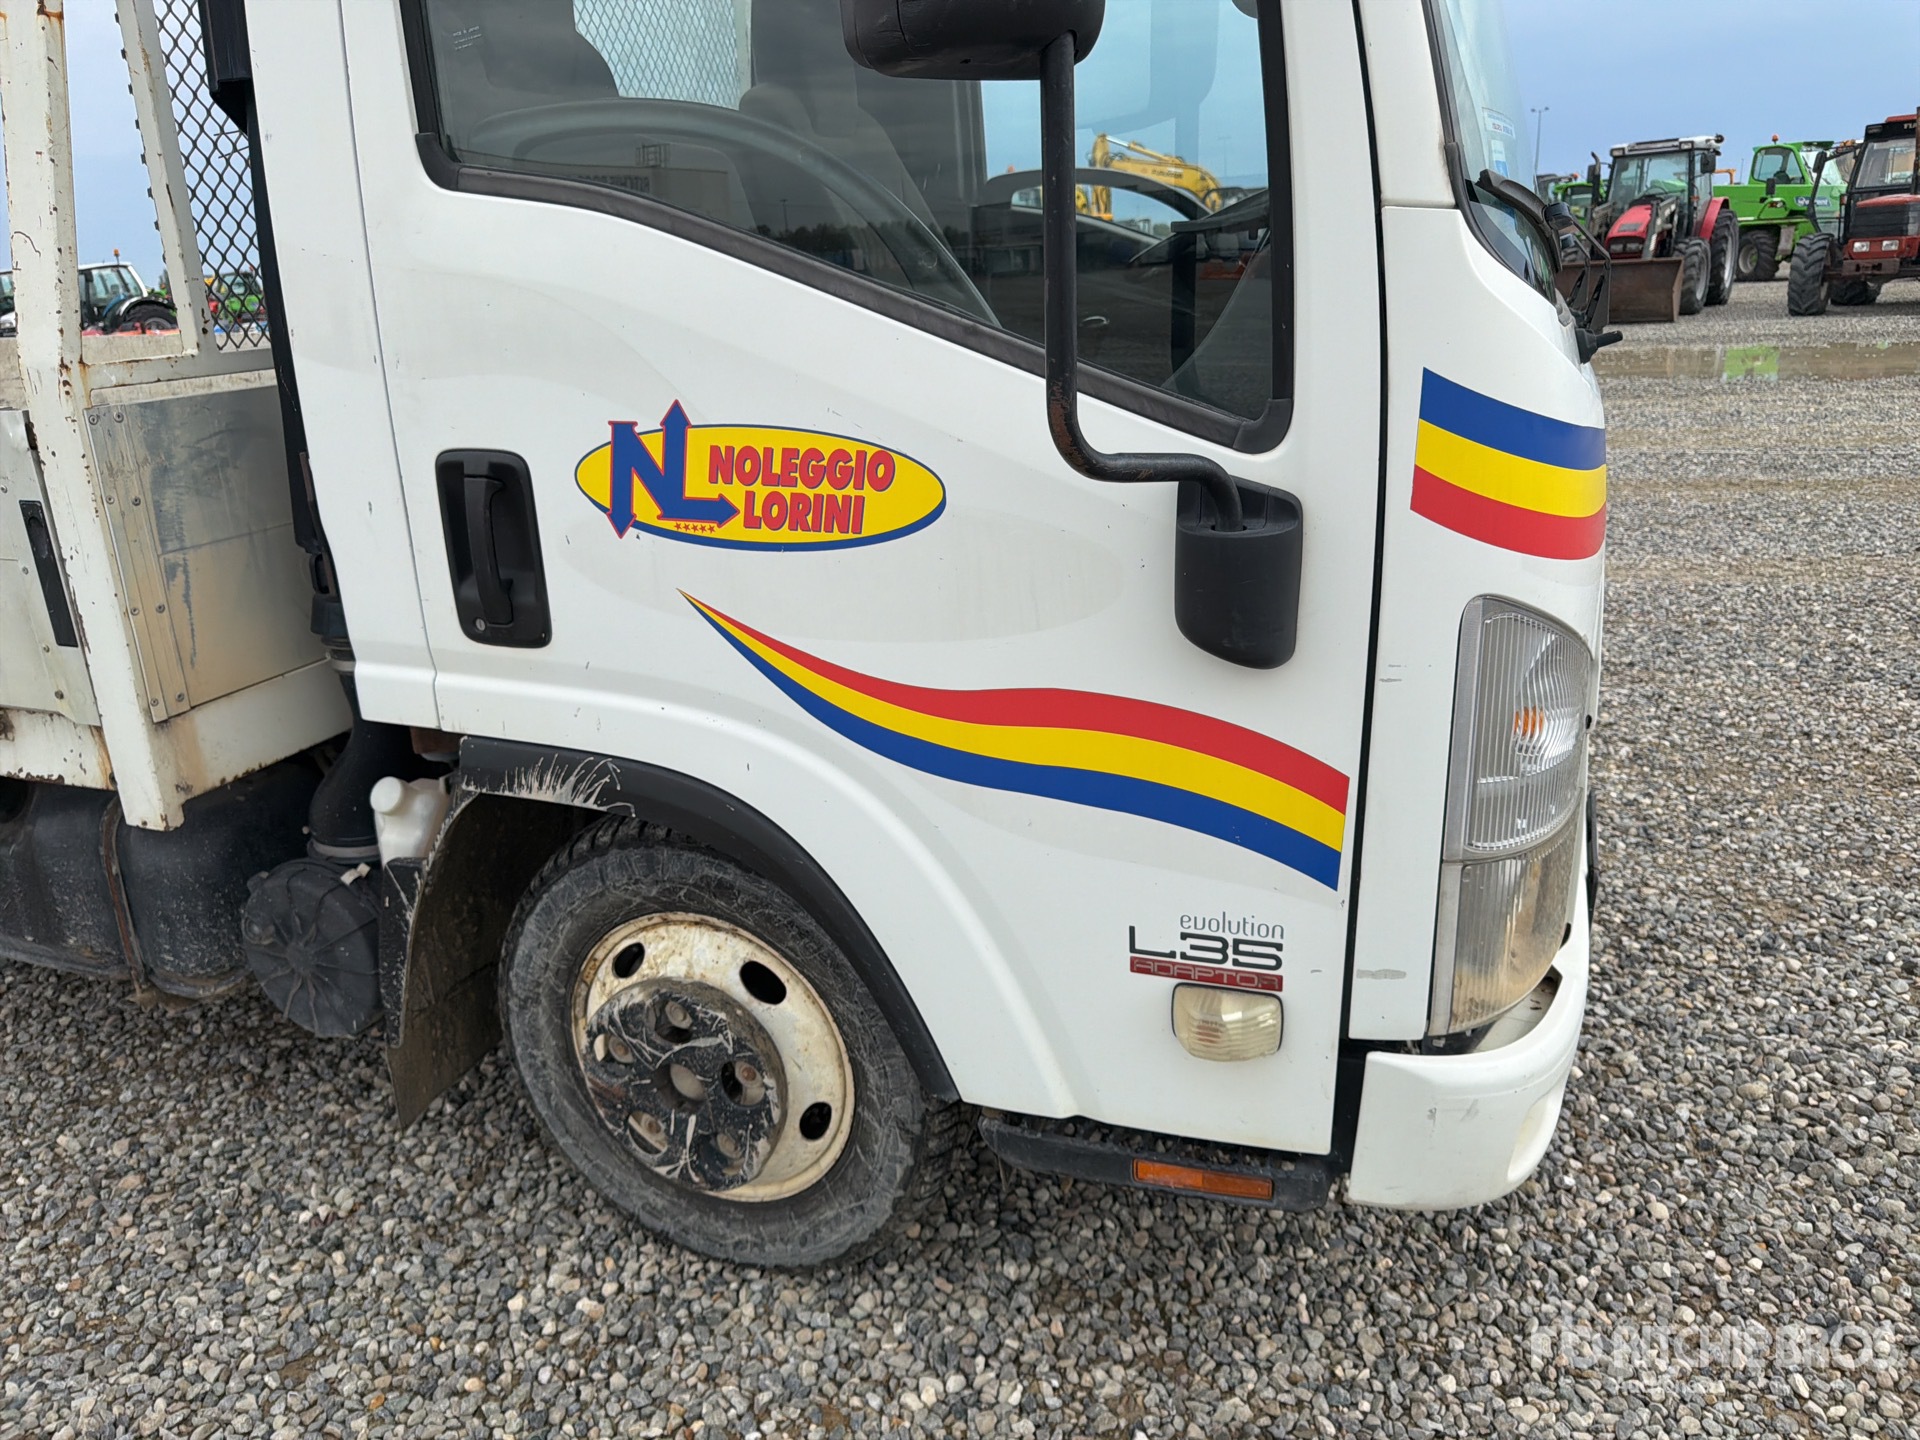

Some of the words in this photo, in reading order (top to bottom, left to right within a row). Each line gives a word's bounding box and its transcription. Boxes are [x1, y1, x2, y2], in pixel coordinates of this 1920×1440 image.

[708, 444, 896, 492] NOLEGGIO
[743, 490, 865, 535] LORINI
[1179, 911, 1285, 940] evolution
[1132, 958, 1281, 991] ADAPTOR
